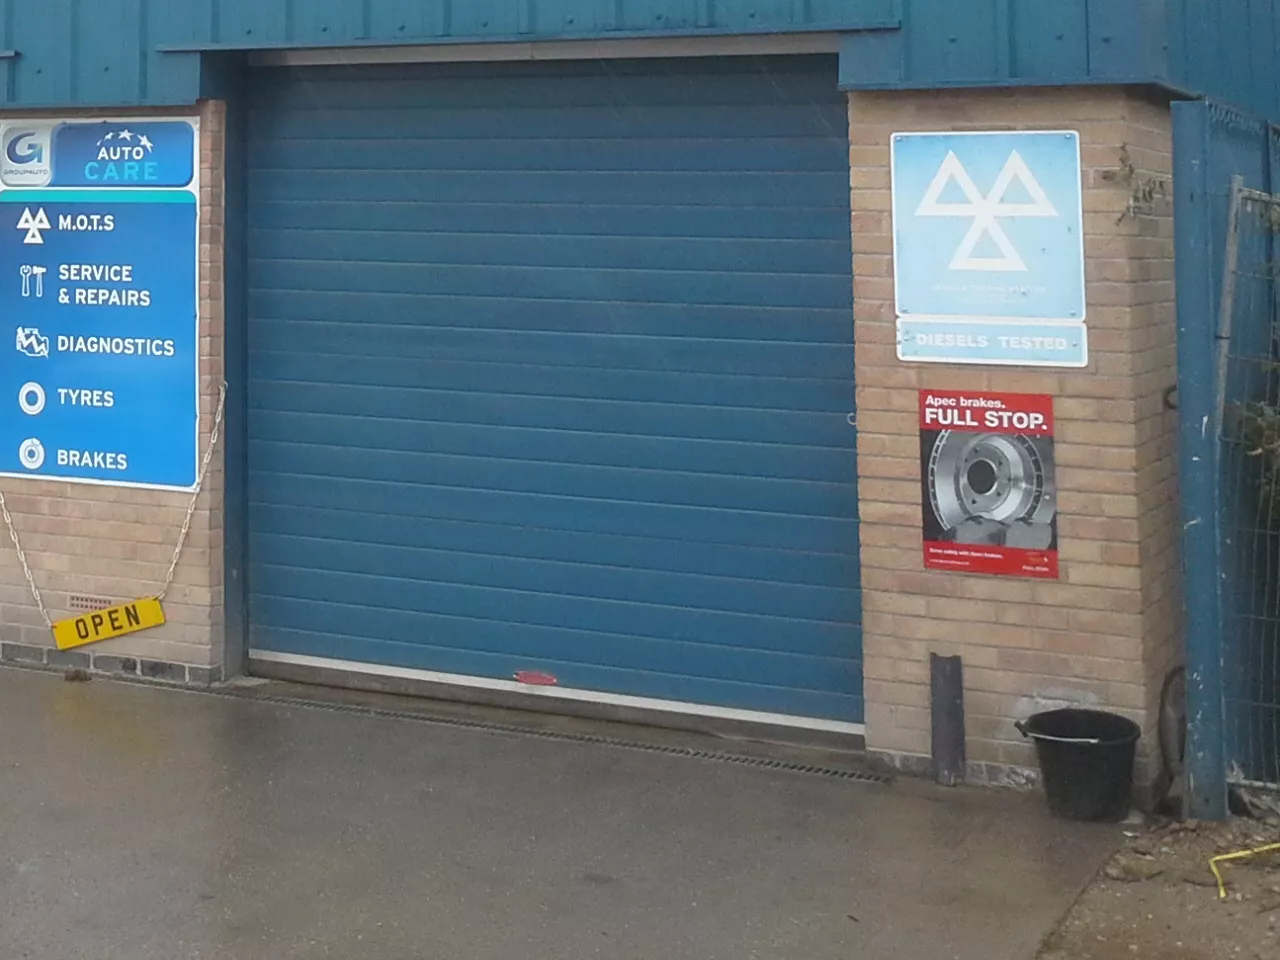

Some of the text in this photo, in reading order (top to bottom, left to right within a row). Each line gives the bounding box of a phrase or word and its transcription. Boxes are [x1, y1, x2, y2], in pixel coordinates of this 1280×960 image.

[97, 146, 144, 161] AUTO
[85, 162, 158, 181] CARE
[58, 214, 114, 231] M.O.T.S
[58, 264, 132, 282] SERVICE
[58, 288, 151, 307] & REPAIRS
[57, 336, 174, 357] DIAGNOSTICS
[915, 333, 1067, 350] DIESELS TESTED
[58, 388, 114, 407] TYRES
[925, 395, 1006, 408] Apec brakes.
[925, 407, 1048, 430] FULL STOP.
[57, 450, 127, 470] BRAKES
[75, 604, 140, 640] OPEN
